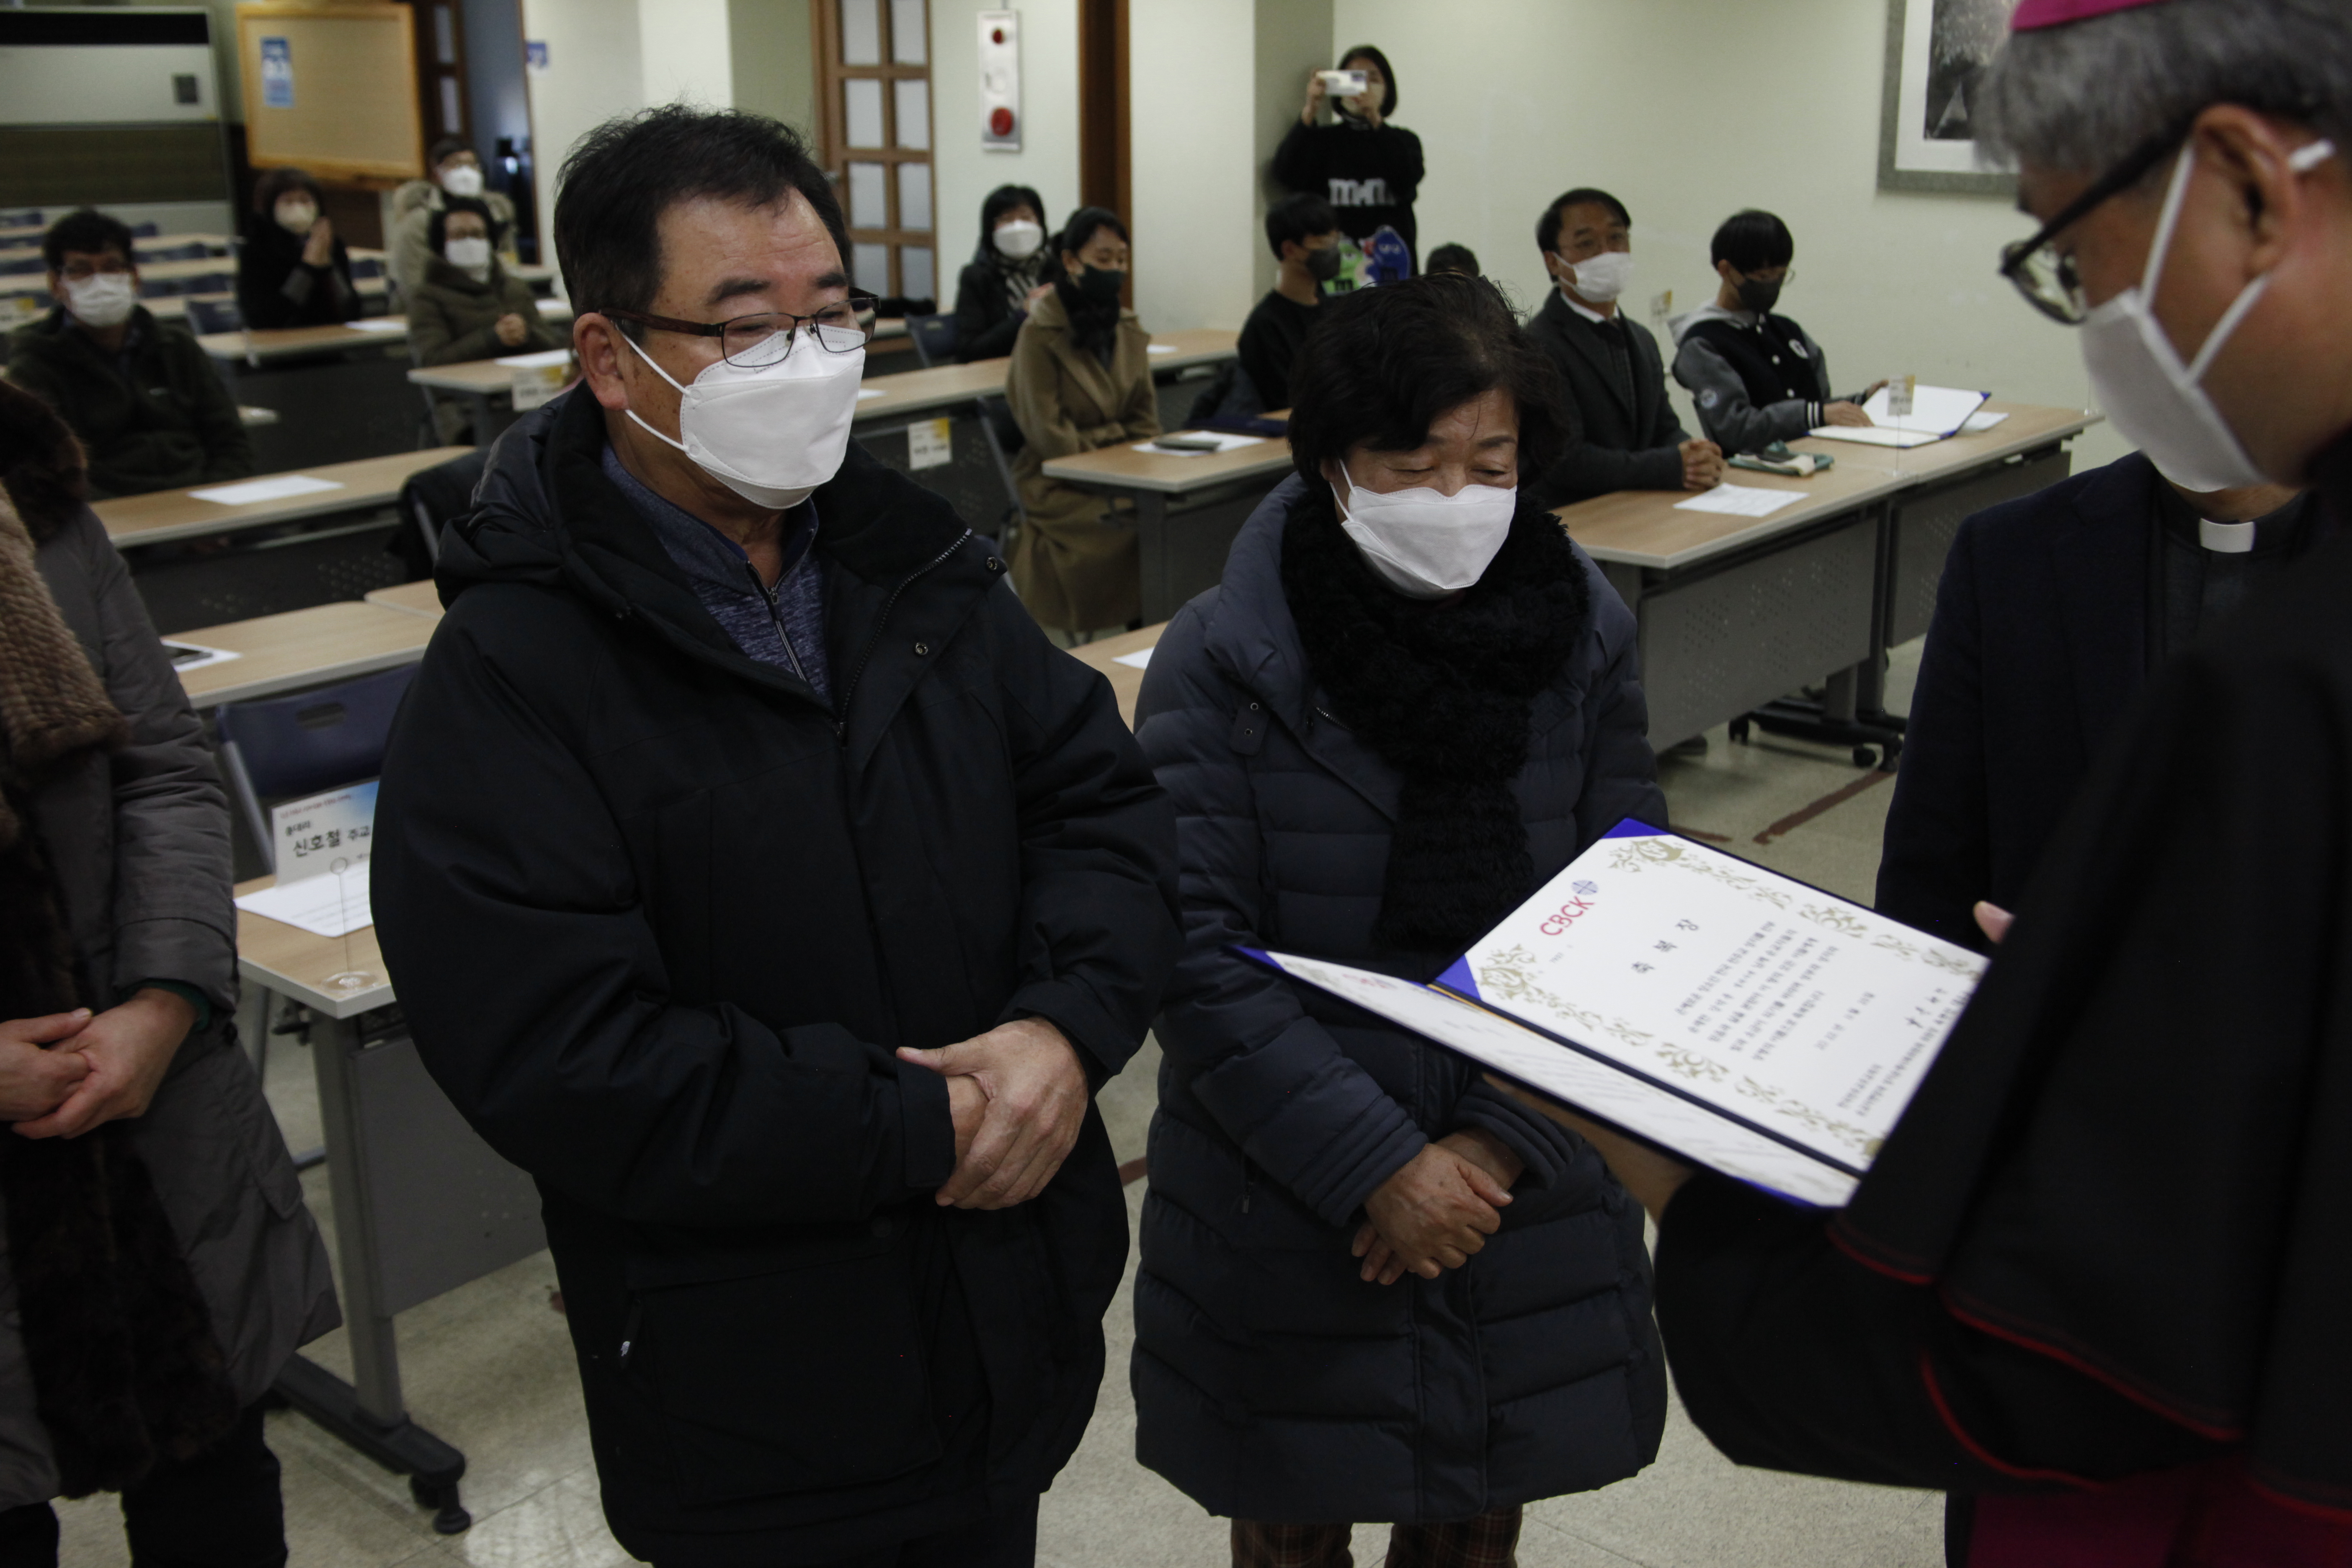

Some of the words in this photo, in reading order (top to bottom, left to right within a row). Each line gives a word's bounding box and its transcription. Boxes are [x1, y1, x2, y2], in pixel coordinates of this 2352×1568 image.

[294, 828, 340, 858] 신호철
[348, 825, 370, 840] 주교
[1540, 895, 1595, 936] CBCK
[1632, 962, 1654, 973] 축
[1653, 940, 1677, 952] 복
[1676, 919, 1699, 931] 장
